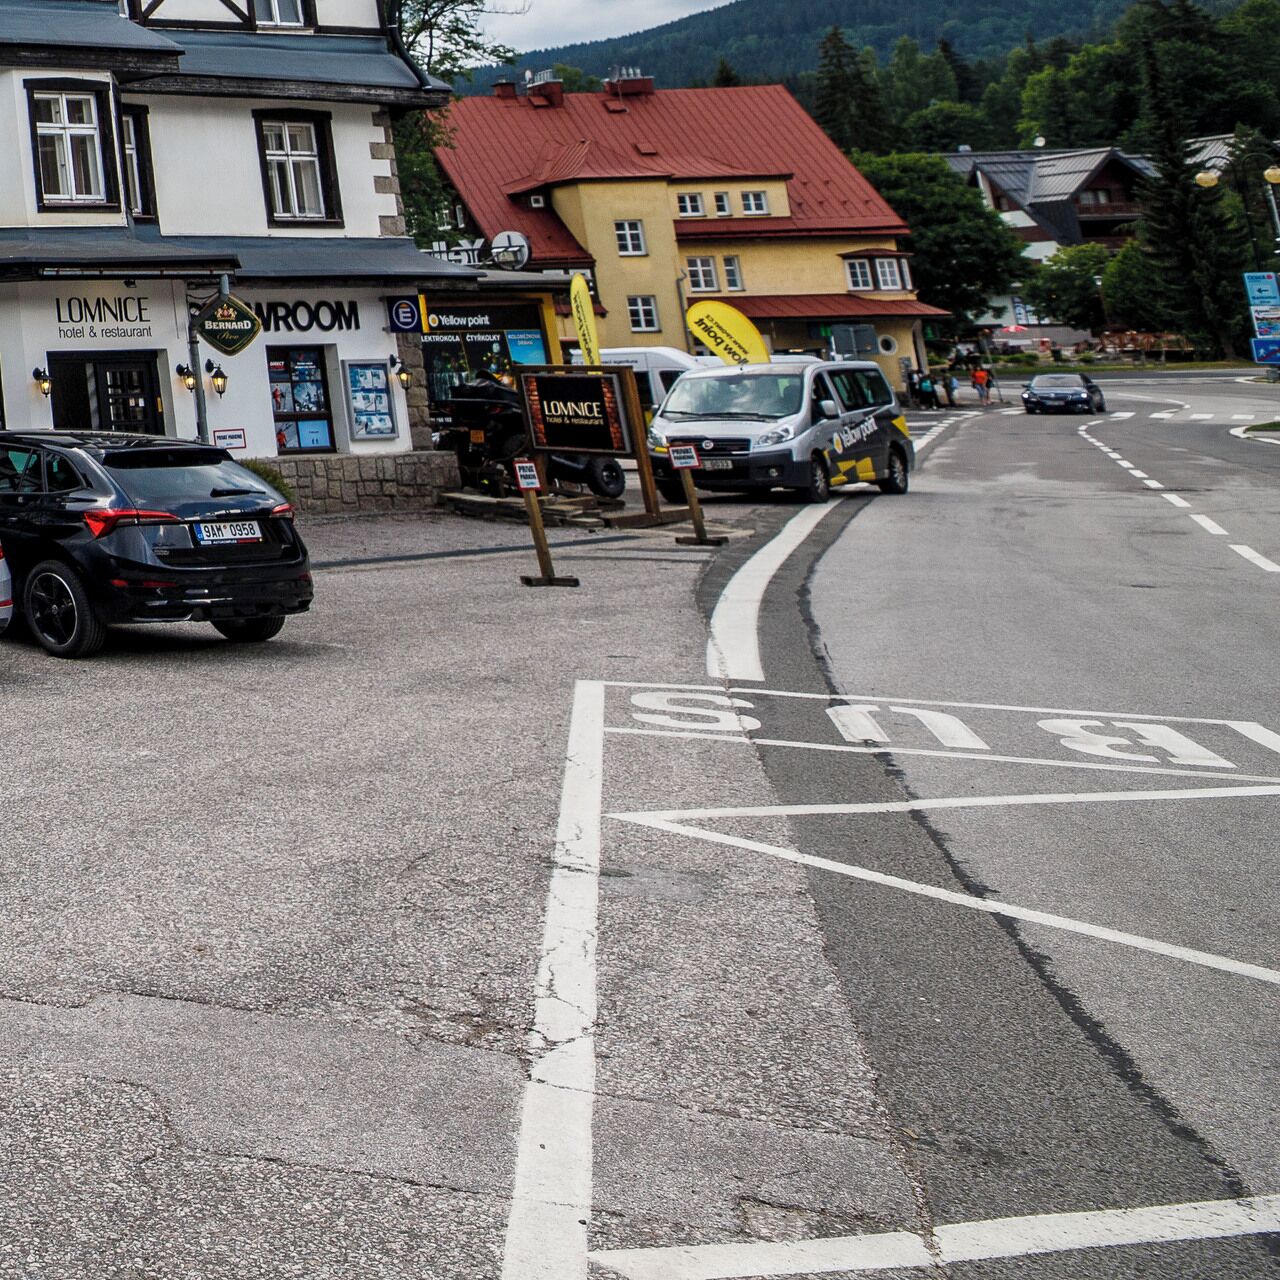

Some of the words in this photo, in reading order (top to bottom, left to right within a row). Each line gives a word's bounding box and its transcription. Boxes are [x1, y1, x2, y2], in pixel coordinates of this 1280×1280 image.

[56, 297, 151, 323] LOMNICE
[189, 300, 360, 332] WROOM
[204, 320, 252, 330] BERNARD
[439, 315, 467, 326] Yellow
[467, 315, 490, 327] point
[59, 326, 85, 338] hotel
[88, 326, 97, 338] &
[101, 326, 152, 338] restaurant
[421, 334, 460, 342] LEKTROKOLA
[543, 400, 603, 417] LOMNICE
[839, 426, 861, 448] Yellow
[229, 523, 256, 537] 0958
[630, 690, 1239, 768] BUS
